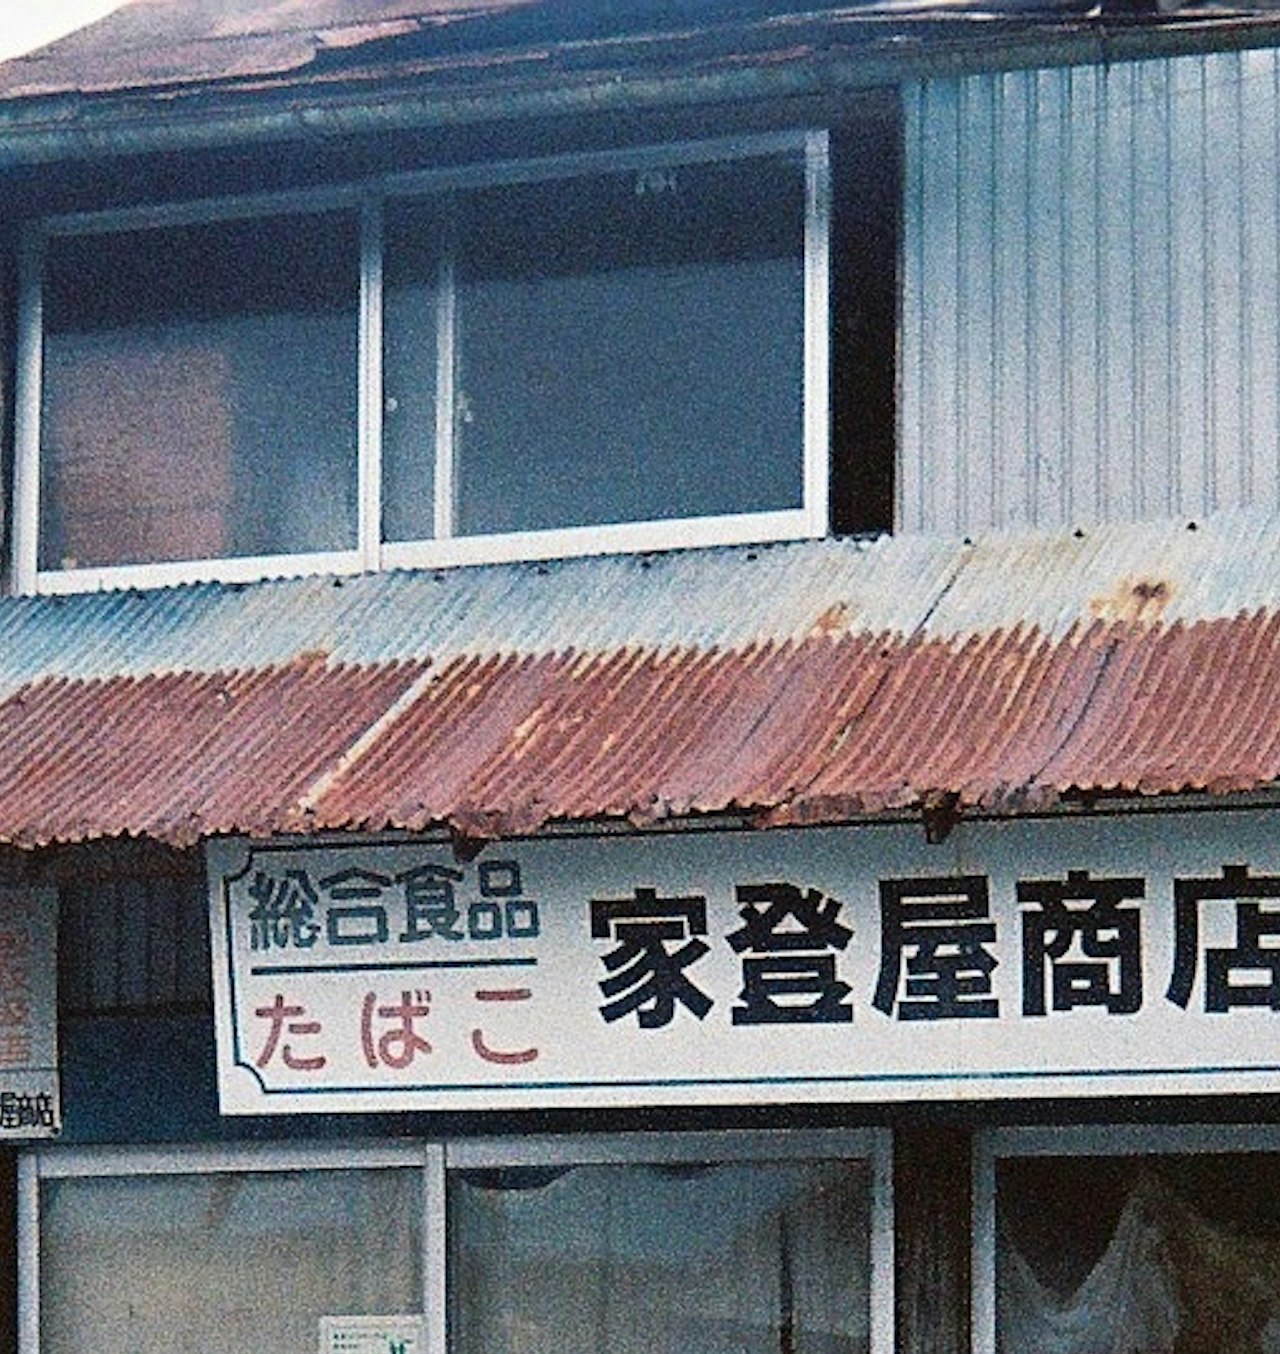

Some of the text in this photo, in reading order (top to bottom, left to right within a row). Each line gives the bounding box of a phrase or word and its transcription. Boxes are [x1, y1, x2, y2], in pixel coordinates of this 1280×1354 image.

[249, 860, 540, 951] 総合食品
[255, 988, 540, 1070] たばこ
